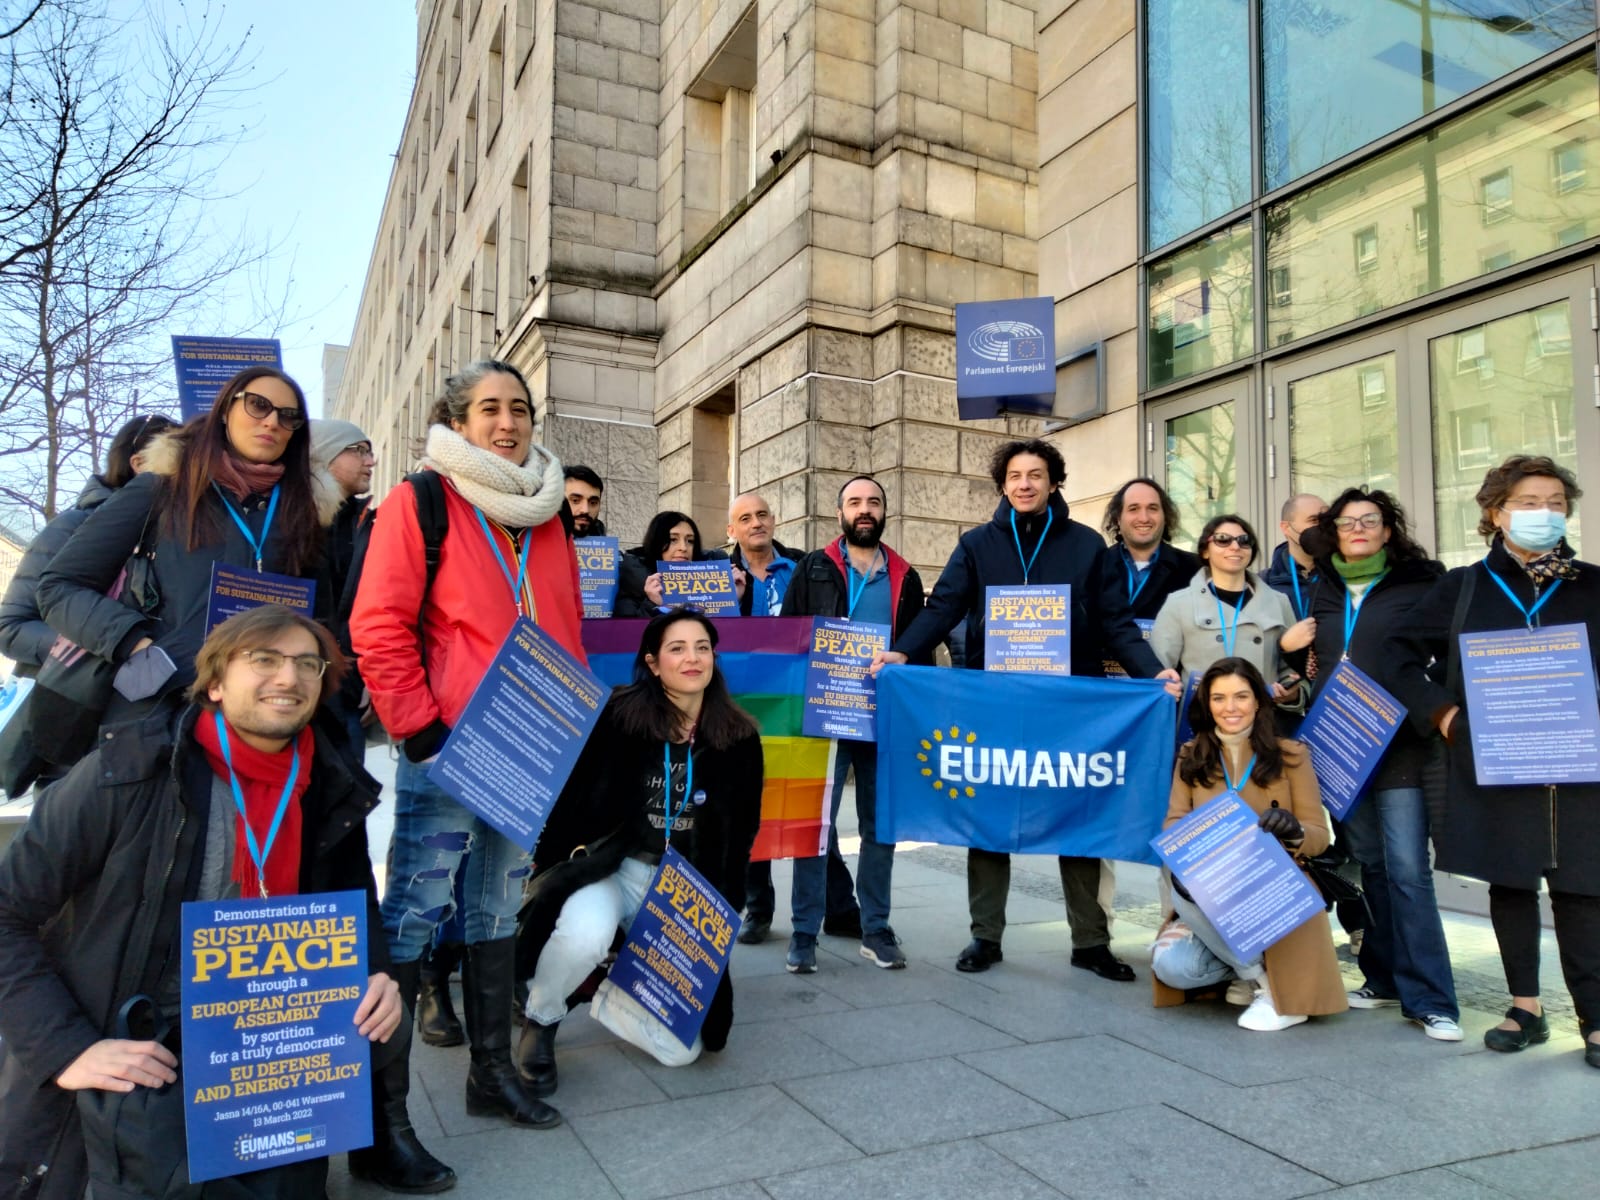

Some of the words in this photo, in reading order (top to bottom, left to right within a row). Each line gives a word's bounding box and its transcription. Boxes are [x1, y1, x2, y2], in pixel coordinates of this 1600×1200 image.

[198, 353, 250, 361] SUSTAINABLE
[965, 366, 1005, 376] Parlament
[1006, 362, 1046, 373] Europejski
[576, 547, 614, 556] INABLE
[577, 556, 615, 571] ACE
[662, 571, 729, 581] SUSTAINABLE
[663, 579, 732, 595] PEACE
[230, 588, 281, 604] SUSTAINABLE
[990, 596, 1065, 606] SUSTAINABLE
[990, 605, 1066, 621] PEACE
[815, 628, 886, 645] SUSTAINABLE
[824, 621, 864, 633] Demonstration
[864, 626, 873, 634] for
[834, 656, 857, 666] through
[1467, 650, 1485, 658] FOR
[1487, 646, 1547, 656] SUSTAINABLE
[514, 634, 530, 651] FOR
[529, 647, 576, 690] SUSTAINABLE
[574, 686, 598, 709] PEACE!
[811, 661, 850, 672] EUROPEAN
[827, 670, 866, 680] ASSEMBLY
[808, 697, 824, 705] AND
[825, 698, 854, 709] ENERGY
[855, 702, 877, 710] POLIC
[824, 691, 835, 699] EU
[835, 693, 868, 703] DEFENSE
[939, 744, 1126, 788] EUMANS!
[662, 864, 732, 938] SUSTAINABLE
[676, 861, 716, 904] Demonstration
[715, 900, 724, 913] for
[723, 910, 728, 918] a
[214, 904, 307, 922] Demonstration
[309, 902, 326, 915] for
[328, 903, 337, 913] a
[655, 873, 729, 955] PEACE
[193, 916, 357, 948] SUSTAINABLE
[646, 900, 687, 942] EUROPEAN
[685, 937, 719, 973] CITIZENS
[673, 912, 696, 938] through
[660, 924, 700, 962] ASSEMBLY
[660, 934, 669, 946] by
[668, 943, 692, 969] sortition
[192, 934, 358, 983] PEACE
[642, 929, 653, 942] for
[656, 942, 672, 959] truly
[671, 956, 702, 989] democratic
[647, 946, 660, 960] EU
[659, 956, 692, 991] DEFENSE
[247, 977, 298, 994] through
[300, 978, 309, 988] a
[627, 941, 646, 959] AND
[645, 954, 677, 985] ENERGY
[676, 982, 703, 1011] POLICY
[191, 995, 284, 1019] EUROPEAN
[287, 986, 360, 1006] CITIZENS
[233, 1005, 322, 1030] ASSEMBLY
[241, 1032, 259, 1048] by
[260, 1025, 315, 1043] sortition
[209, 1050, 228, 1065] for
[231, 1052, 240, 1062] a
[242, 1045, 273, 1060] truly
[275, 1033, 346, 1055] democratic
[230, 1065, 254, 1082] EU
[257, 1052, 331, 1078] DEFENSE
[194, 1084, 232, 1104] AND
[235, 1073, 302, 1097] ENERGY
[304, 1062, 363, 1086] POLICY
[214, 1111, 240, 1122] Jasna
[241, 1104, 272, 1117] 14/16A,
[272, 1098, 300, 1111] 00-041
[301, 1091, 345, 1105] Warszawa
[252, 1118, 263, 1128] 13
[263, 1113, 291, 1126] March
[292, 1108, 313, 1120] 2022
[240, 1131, 295, 1155] EUMANS
[257, 1150, 268, 1160] for
[268, 1146, 296, 1158] Ukraine
[304, 1142, 315, 1150] the
[315, 1139, 326, 1148] EU
